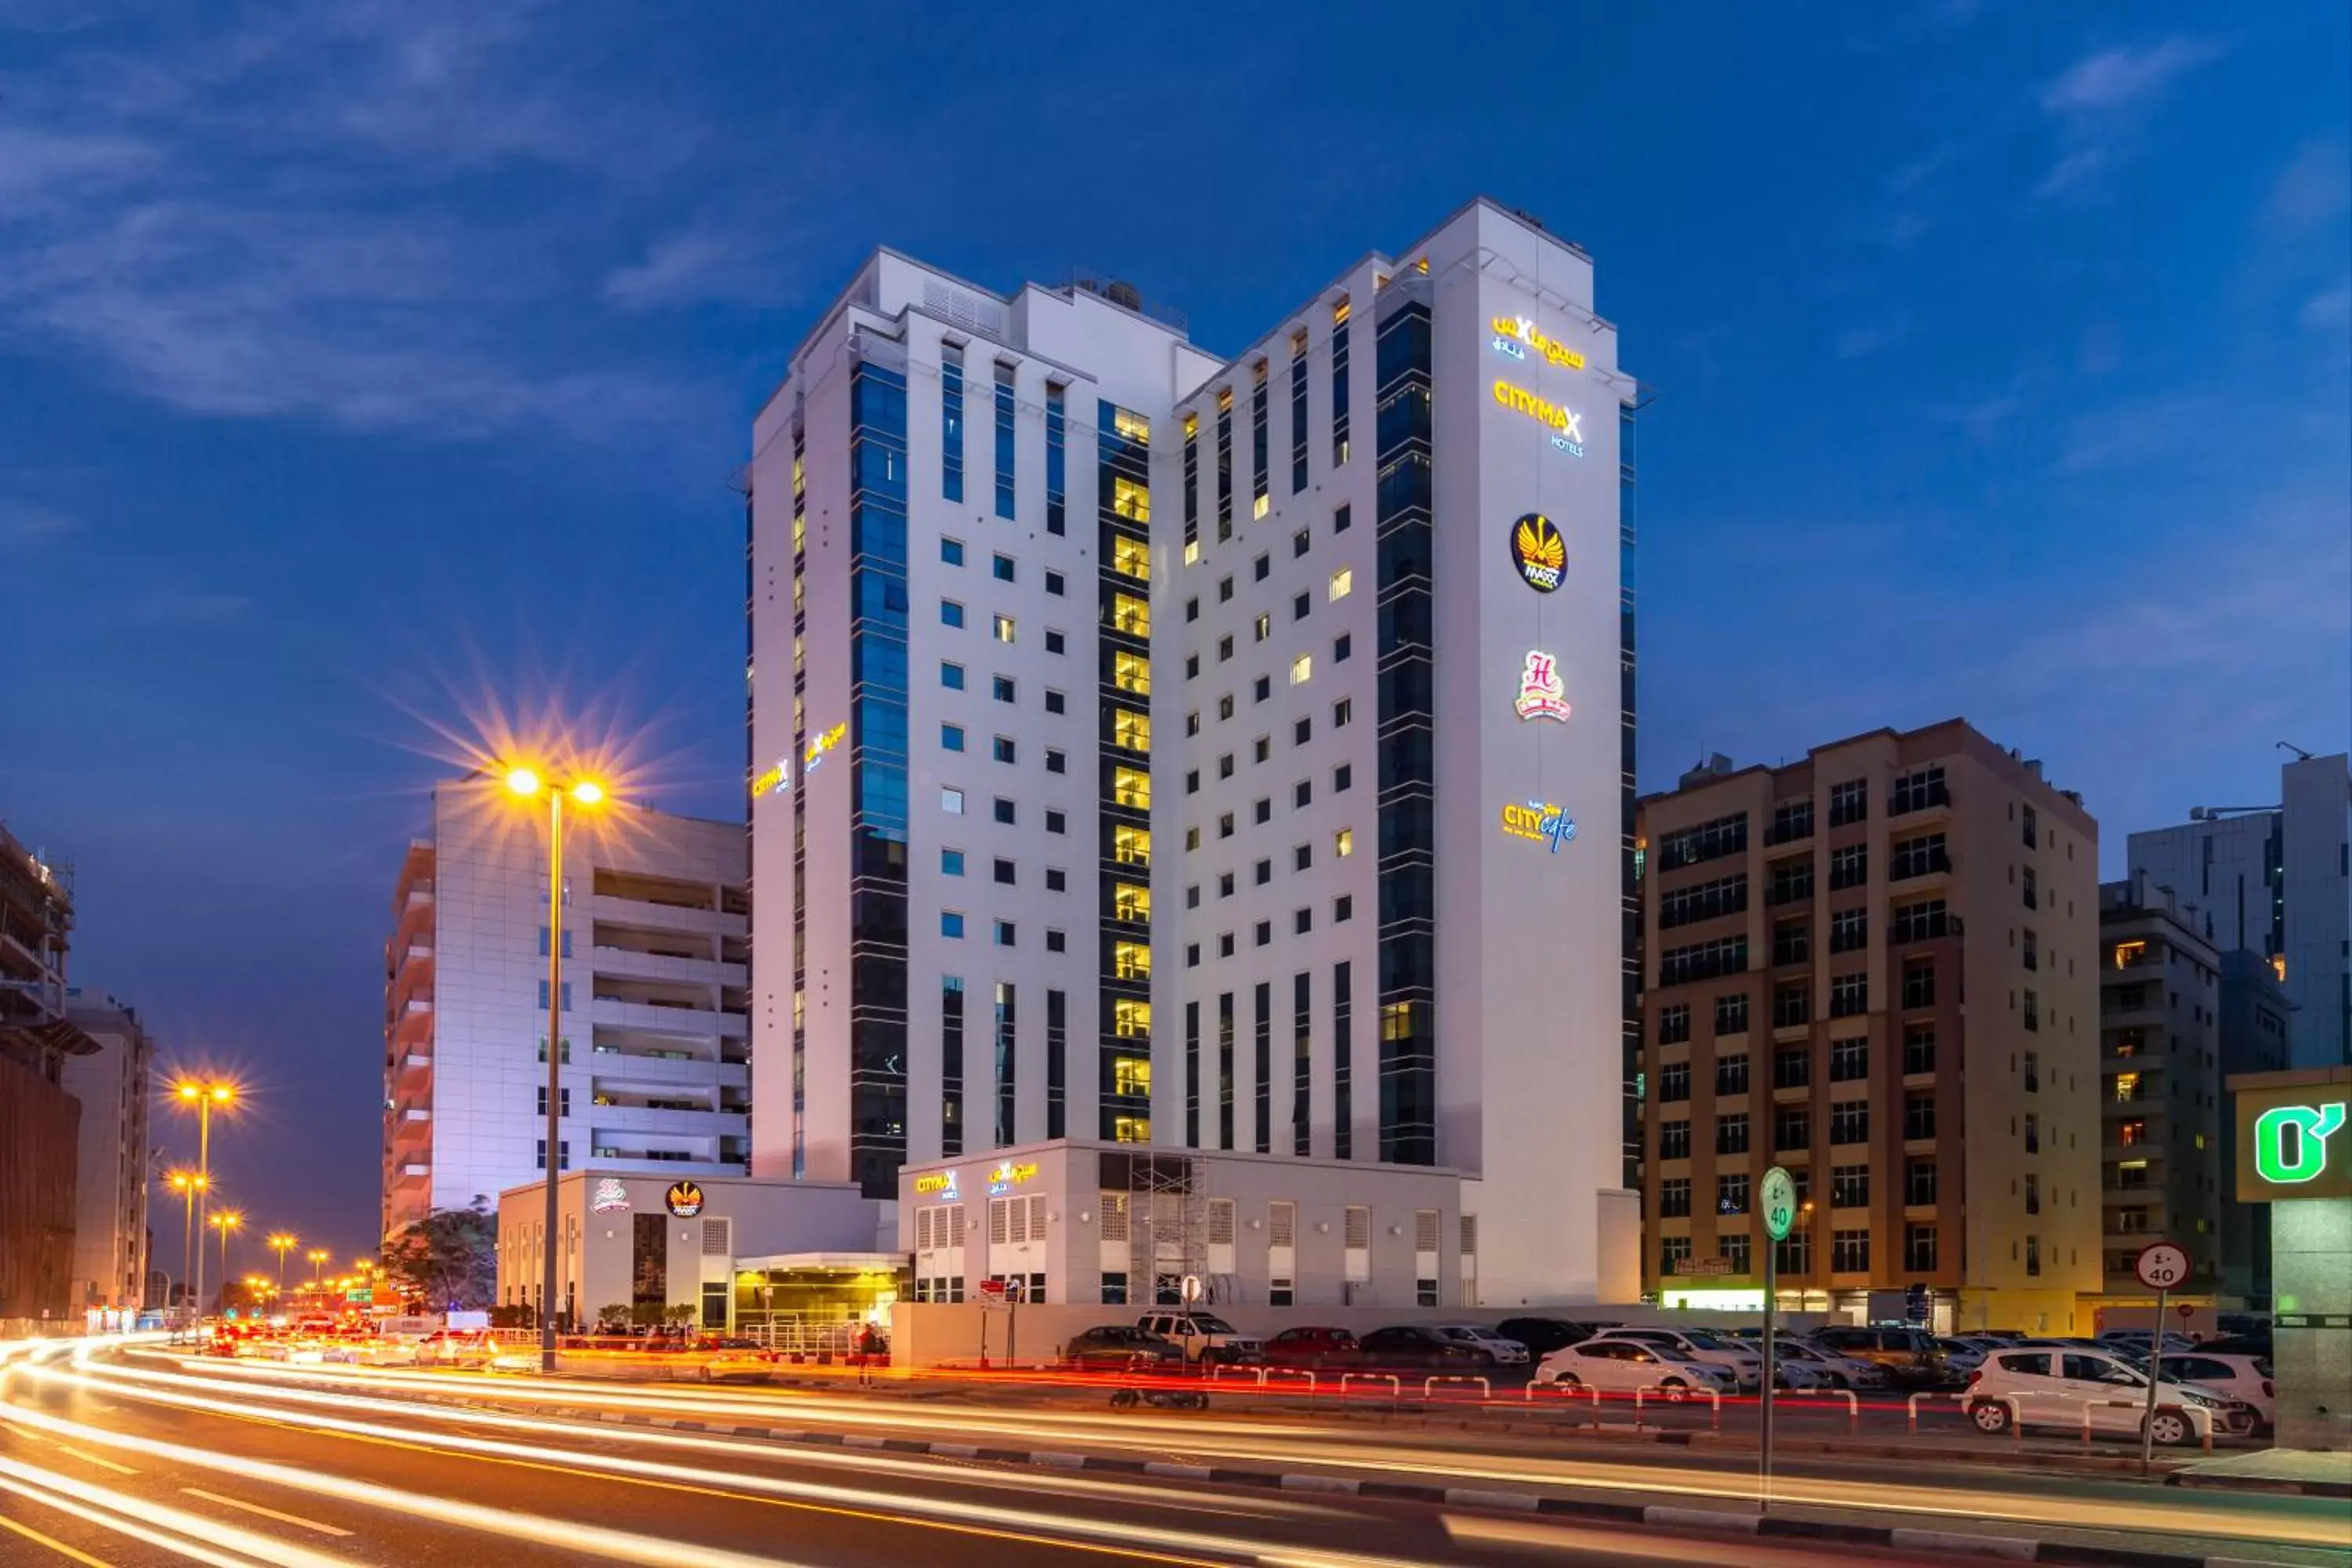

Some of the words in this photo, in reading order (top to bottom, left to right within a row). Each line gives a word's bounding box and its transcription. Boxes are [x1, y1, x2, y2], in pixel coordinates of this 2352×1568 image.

[1494, 380, 1582, 443] CITYMAX
[1551, 435, 1583, 457] HOTELS
[1504, 804, 1543, 832] CITY
[1771, 1207, 1787, 1225] 40
[2149, 1269, 2174, 1283] 40
